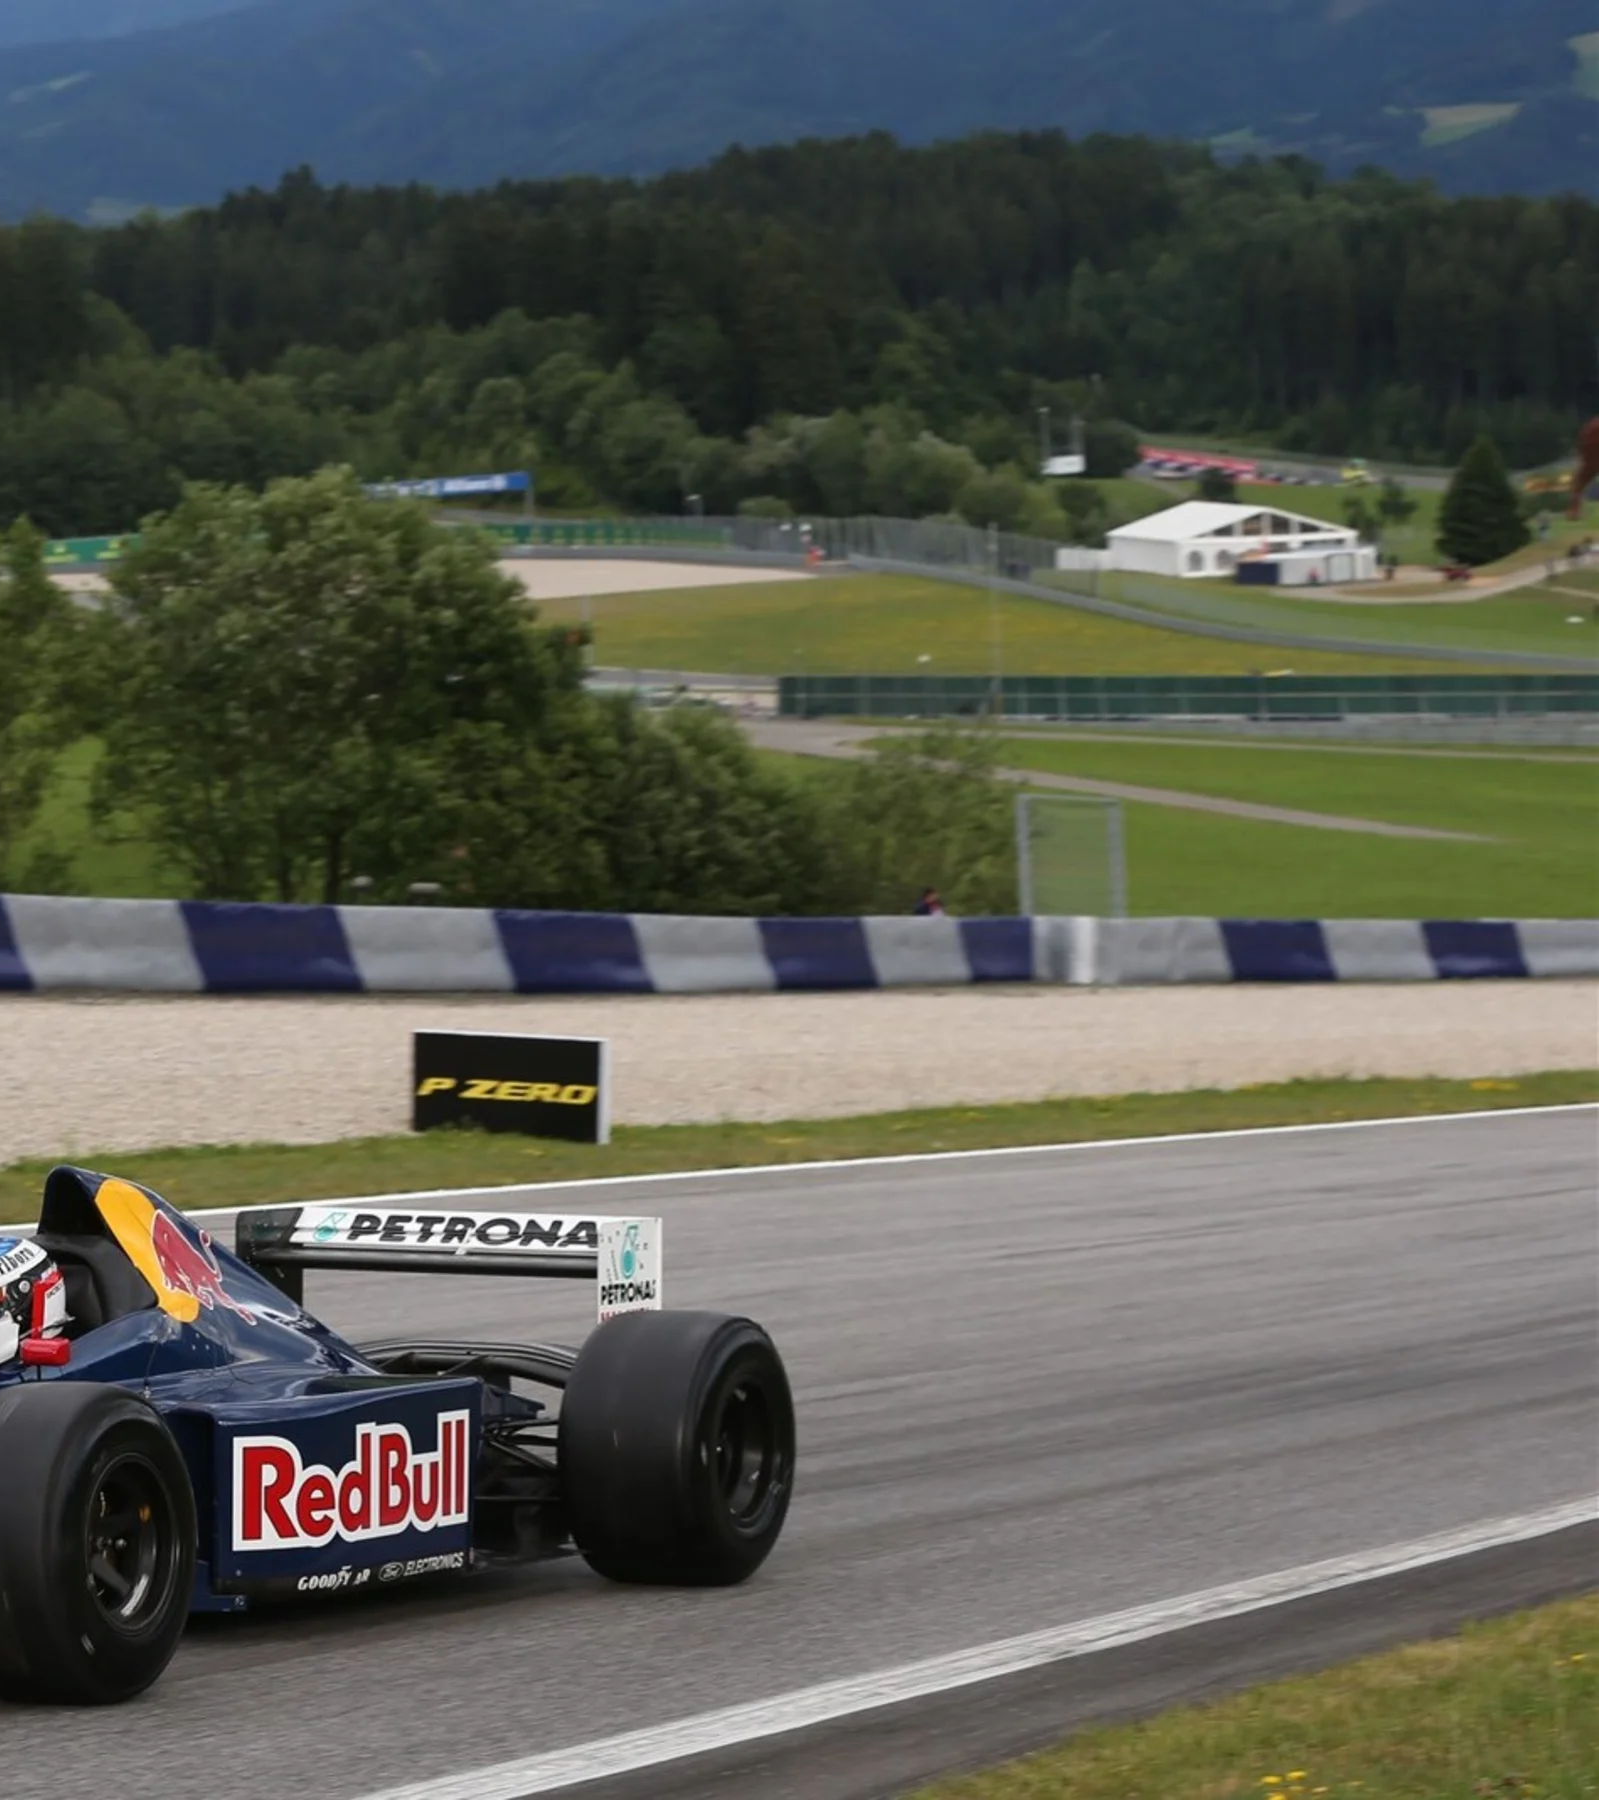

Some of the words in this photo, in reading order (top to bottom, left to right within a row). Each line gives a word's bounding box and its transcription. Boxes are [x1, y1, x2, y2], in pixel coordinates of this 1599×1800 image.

[417, 1077, 457, 1096] P
[458, 1079, 597, 1104] ZERO
[347, 1213, 598, 1248] PETRONA
